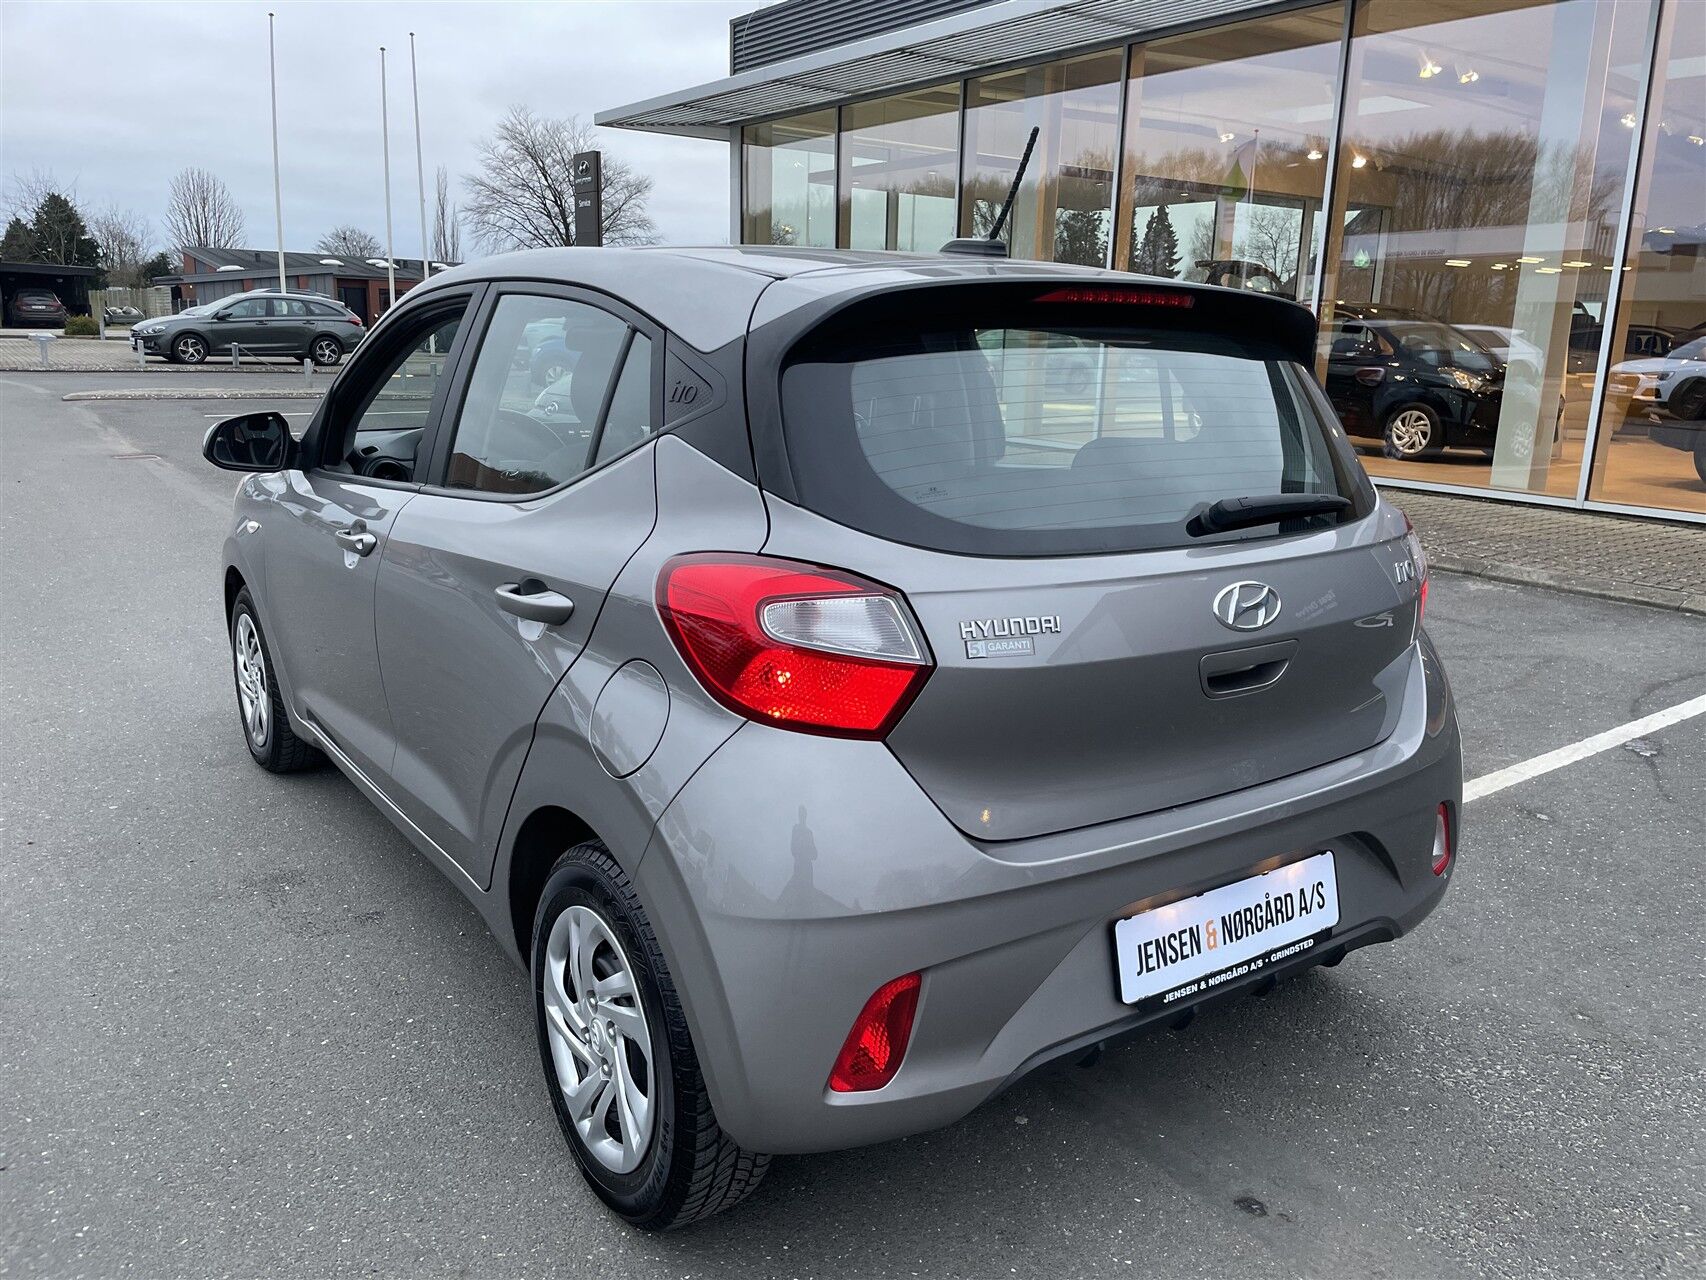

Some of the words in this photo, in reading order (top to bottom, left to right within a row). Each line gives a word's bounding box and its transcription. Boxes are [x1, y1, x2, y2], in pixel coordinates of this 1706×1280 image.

[668, 380, 698, 404] i10
[1394, 560, 1415, 584] i10
[960, 616, 1061, 639] HYUNDAI
[987, 640, 1031, 651] GARANTI
[1136, 924, 1202, 976] JENSEN
[1205, 919, 1218, 951] &
[1221, 892, 1294, 945] NØRGÅRD
[1299, 881, 1325, 917] A/S
[1163, 983, 1198, 1003] JENSEN
[1200, 981, 1207, 990] &
[1208, 965, 1249, 987] NØRGÅRD
[1250, 959, 1264, 971] A/S
[1270, 938, 1314, 962] GRINDSTED
